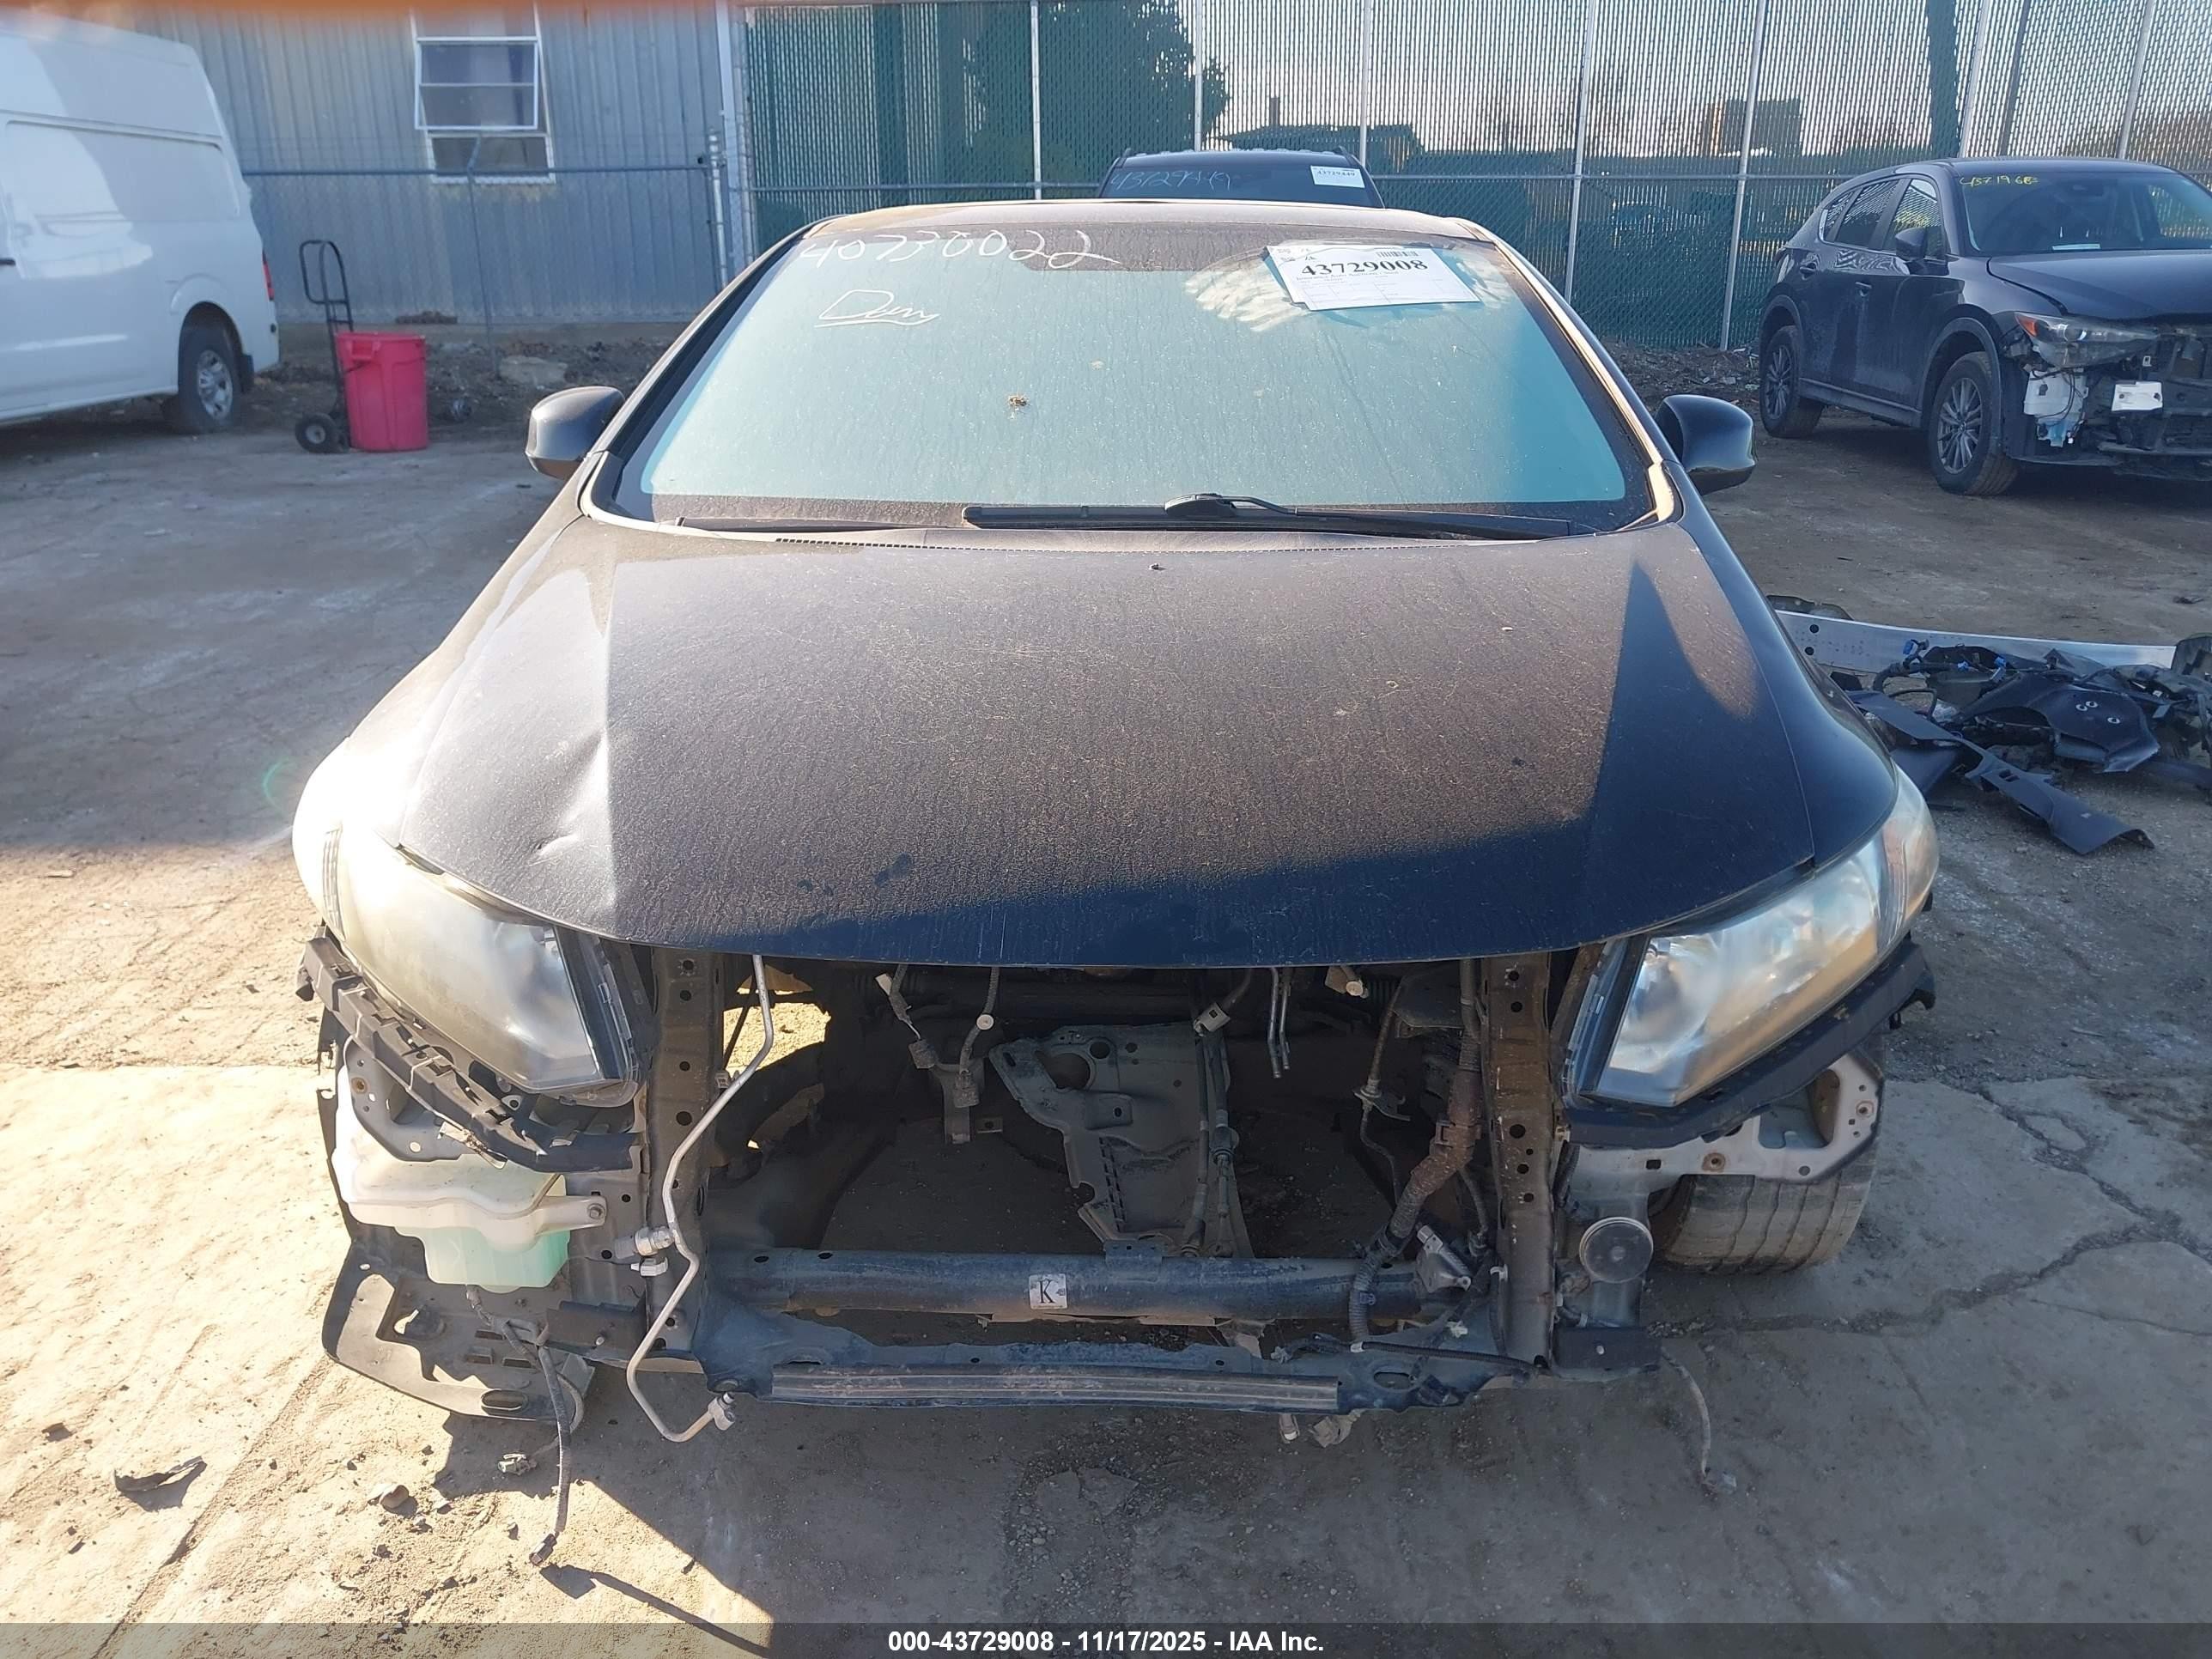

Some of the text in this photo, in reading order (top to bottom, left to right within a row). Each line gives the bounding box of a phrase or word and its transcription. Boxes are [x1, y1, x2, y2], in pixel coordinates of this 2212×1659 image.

[799, 228, 1121, 270] 40730022
[1301, 259, 1428, 276] 43729008
[1037, 1278, 1057, 1304] K
